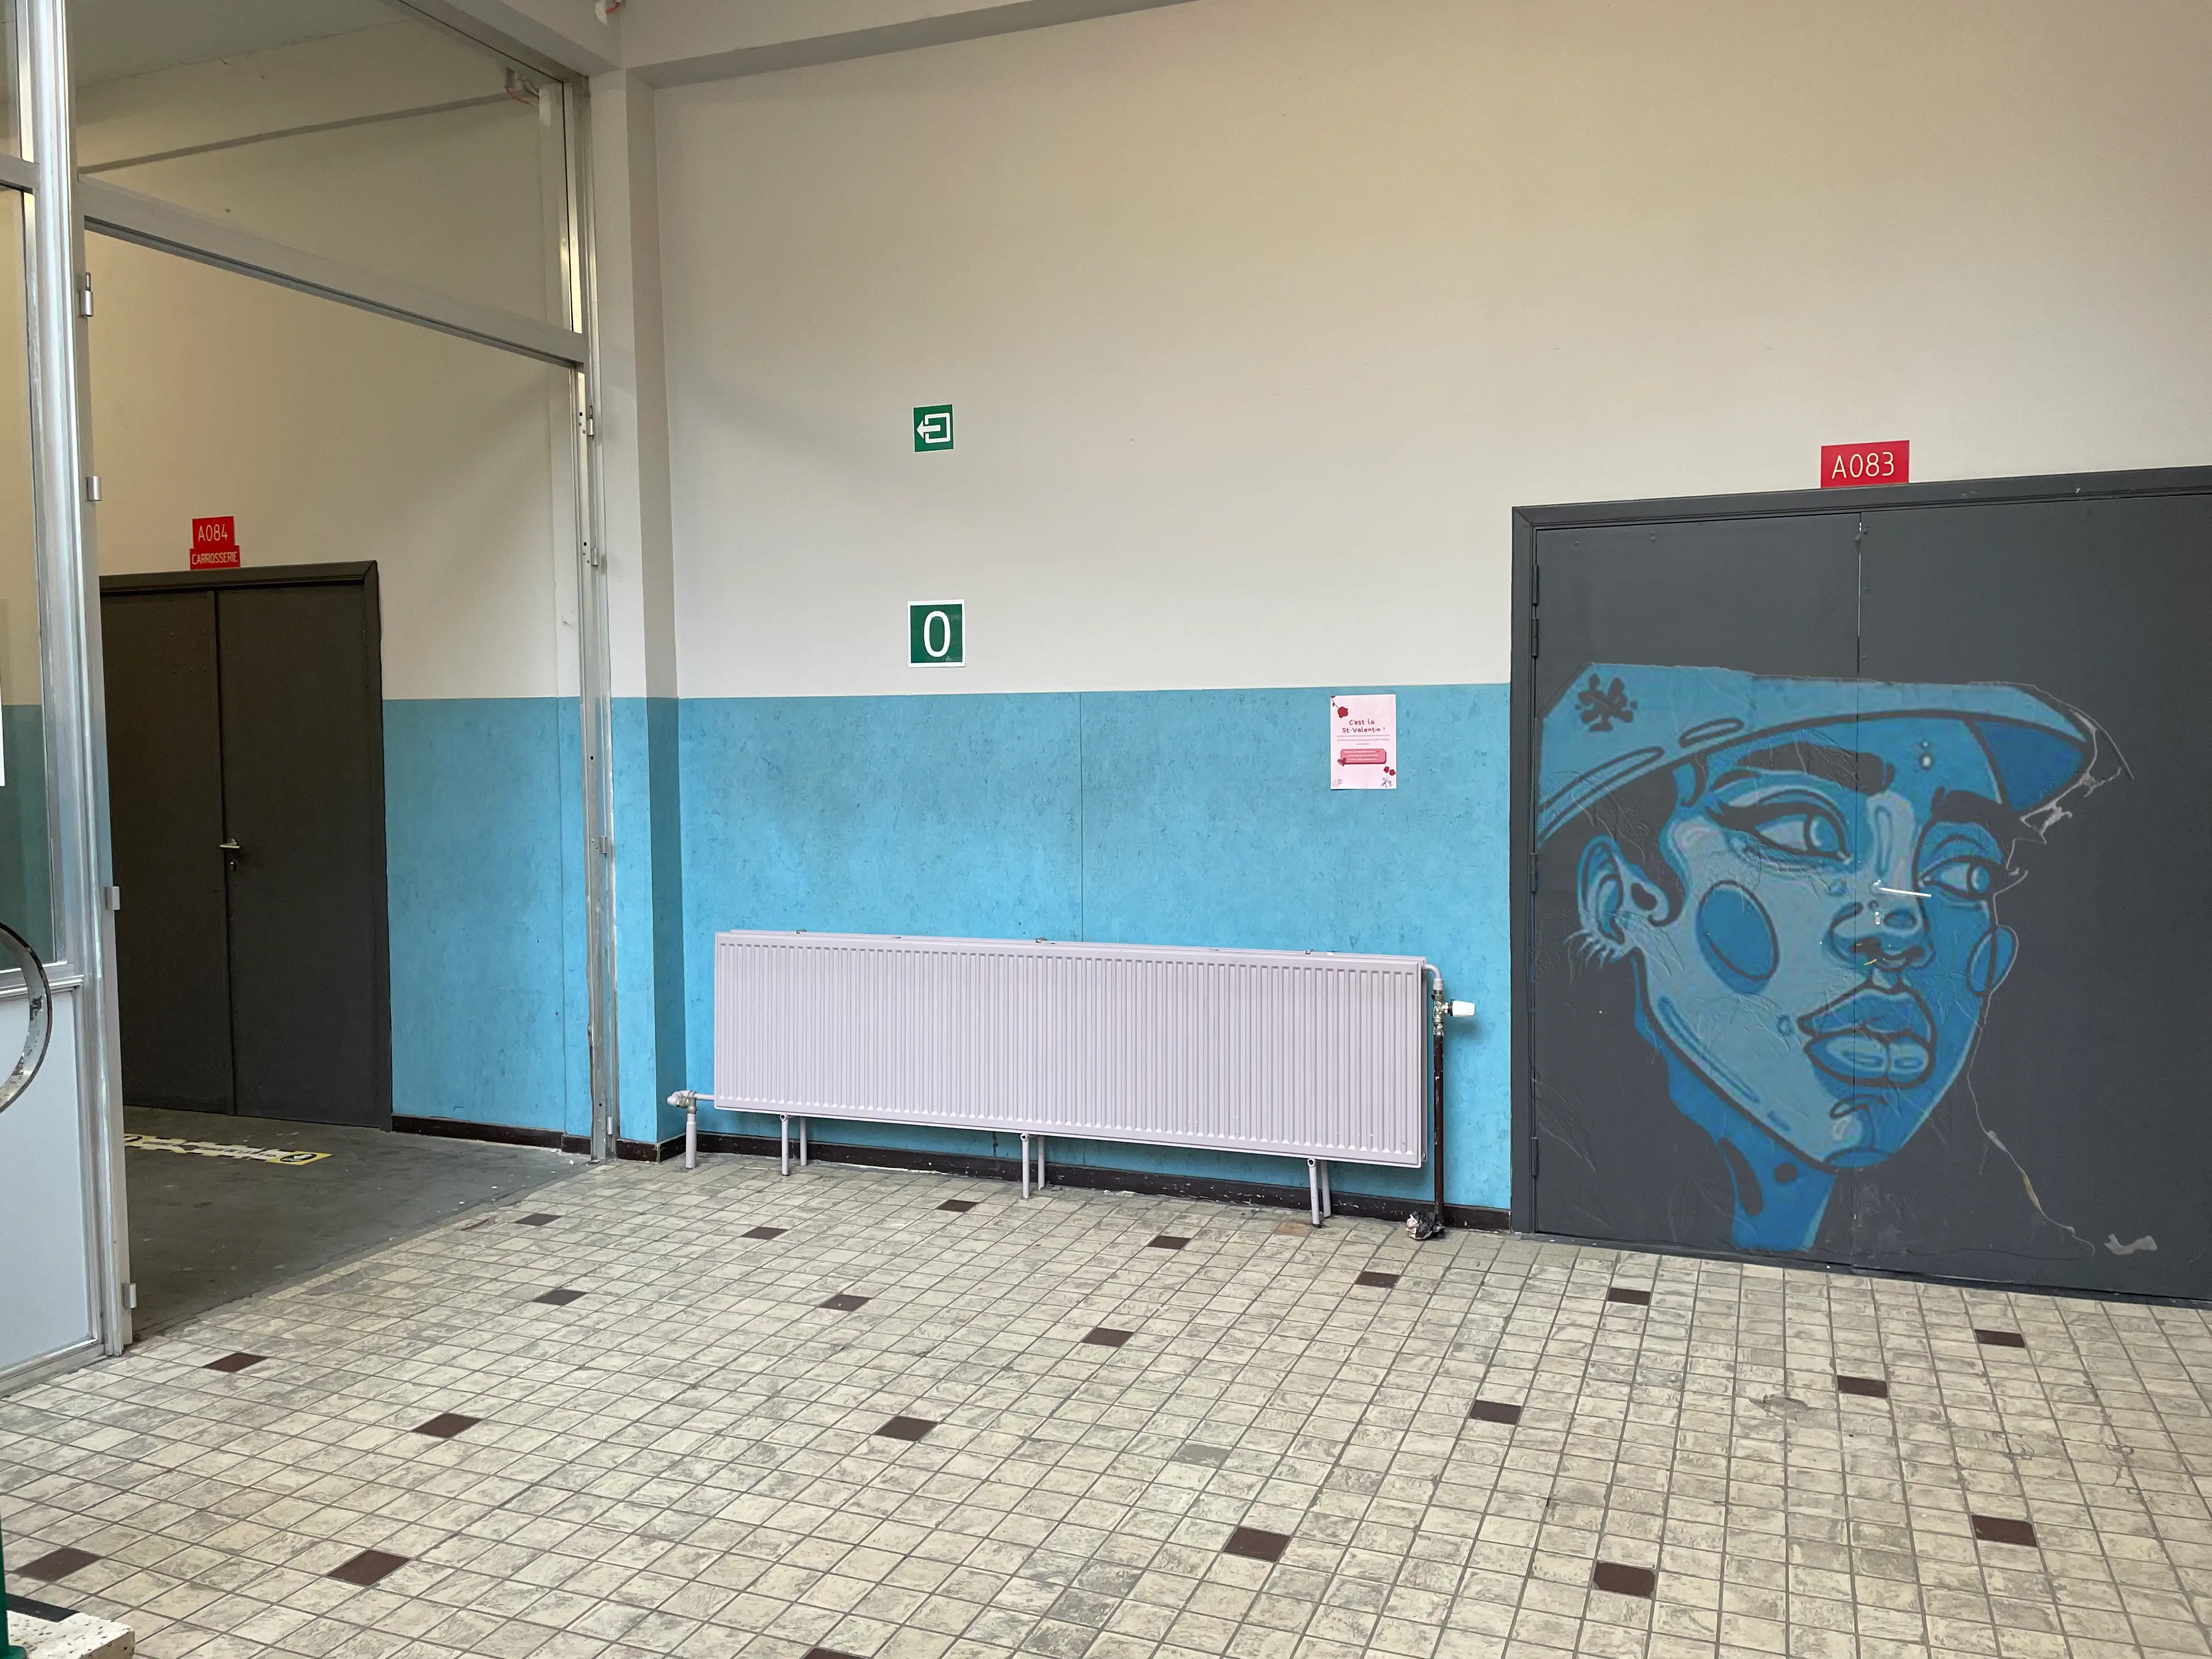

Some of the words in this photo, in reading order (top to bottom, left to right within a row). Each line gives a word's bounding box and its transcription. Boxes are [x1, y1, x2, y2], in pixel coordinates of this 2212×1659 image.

[1831, 452, 1894, 479] A083
[198, 523, 228, 543] A084
[191, 551, 238, 565] CARROSSERIE
[923, 610, 951, 657] 0
